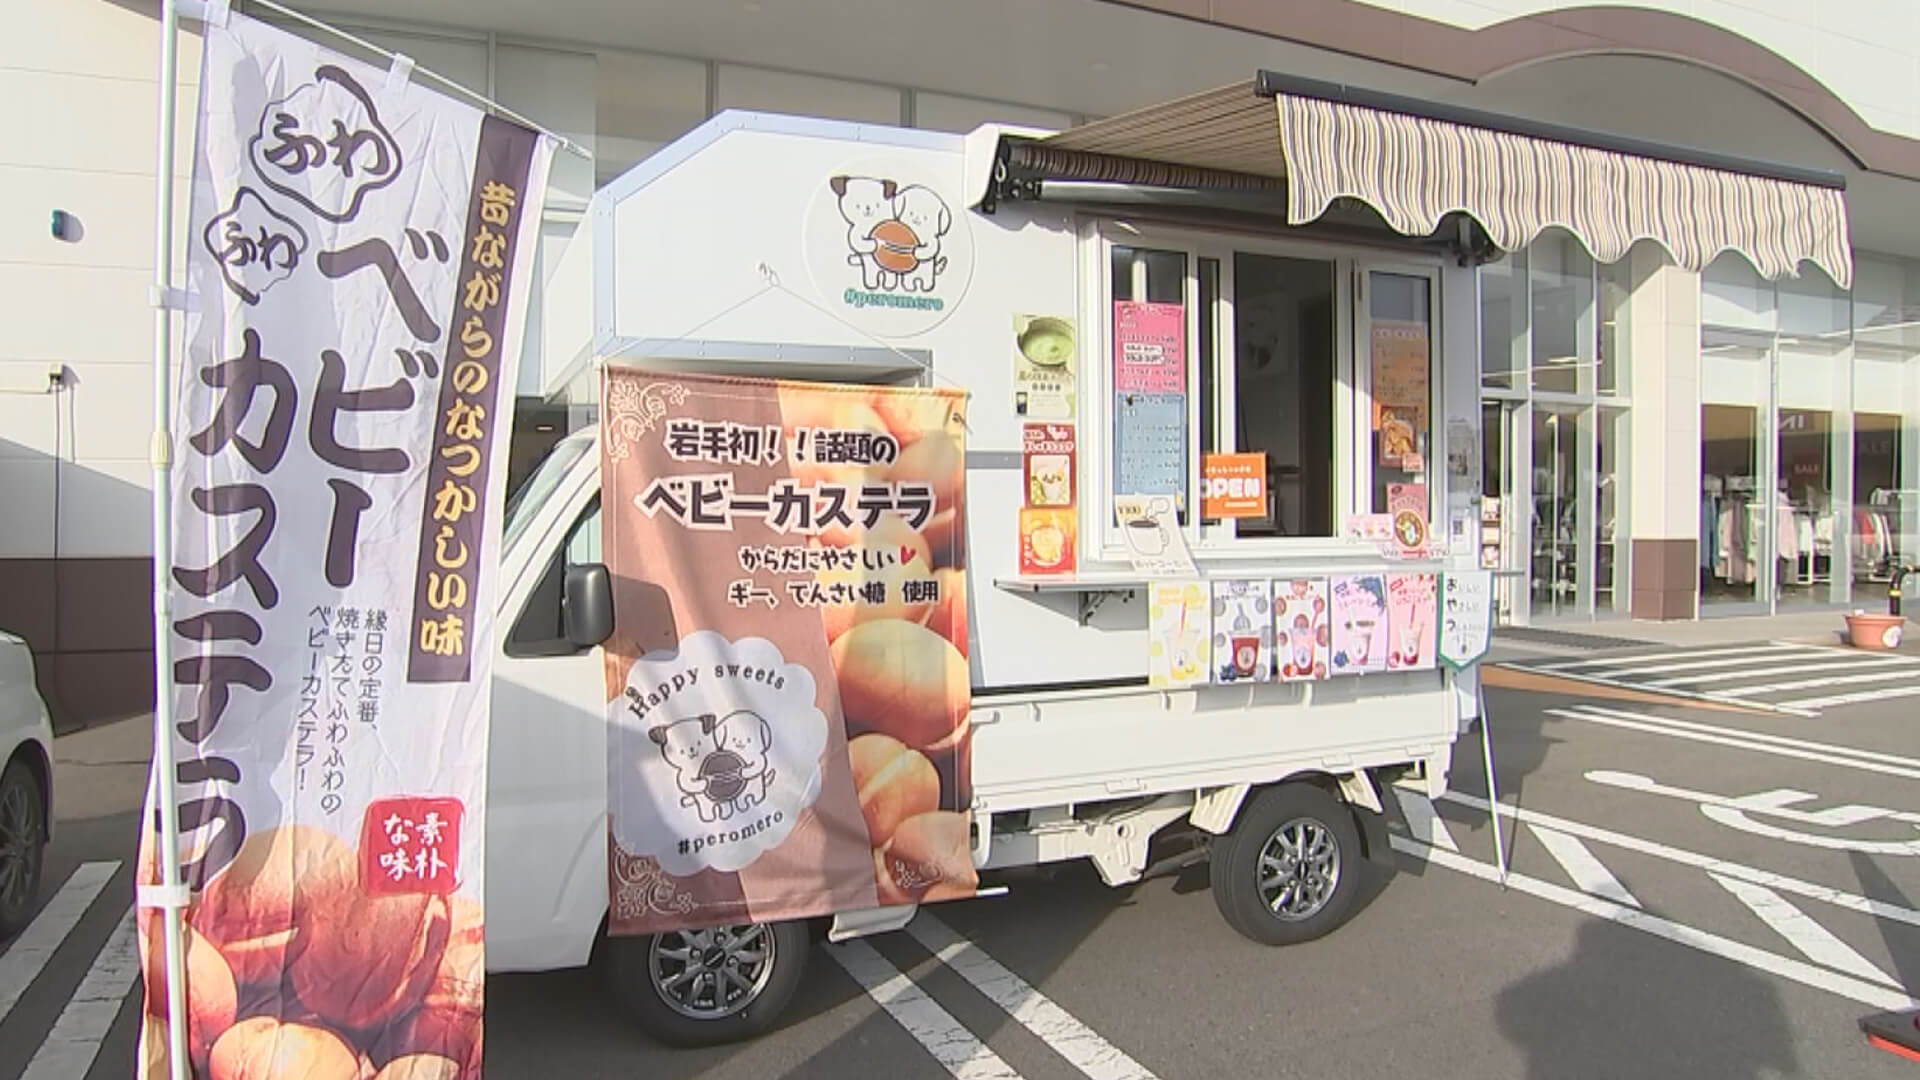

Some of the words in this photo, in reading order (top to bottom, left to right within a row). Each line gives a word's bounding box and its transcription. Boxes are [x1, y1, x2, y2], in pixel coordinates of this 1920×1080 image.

[264, 113, 391, 176] ふわ
[219, 221, 300, 271] ふわ
[309, 228, 451, 587] ベビー
[419, 181, 516, 656] 昔ながらのなつかしい味
[643, 478, 935, 530] ベビーカステラ
[1200, 477, 1261, 499] OPEN
[741, 547, 895, 571] からだにやさしい
[157, 328, 298, 893] カステラ
[902, 580, 939, 602] 使用
[320, 607, 360, 815] 焼きたてふわふわの
[627, 665, 700, 719] Happy
[714, 661, 786, 691] sweets
[677, 810, 784, 856] #peromero
